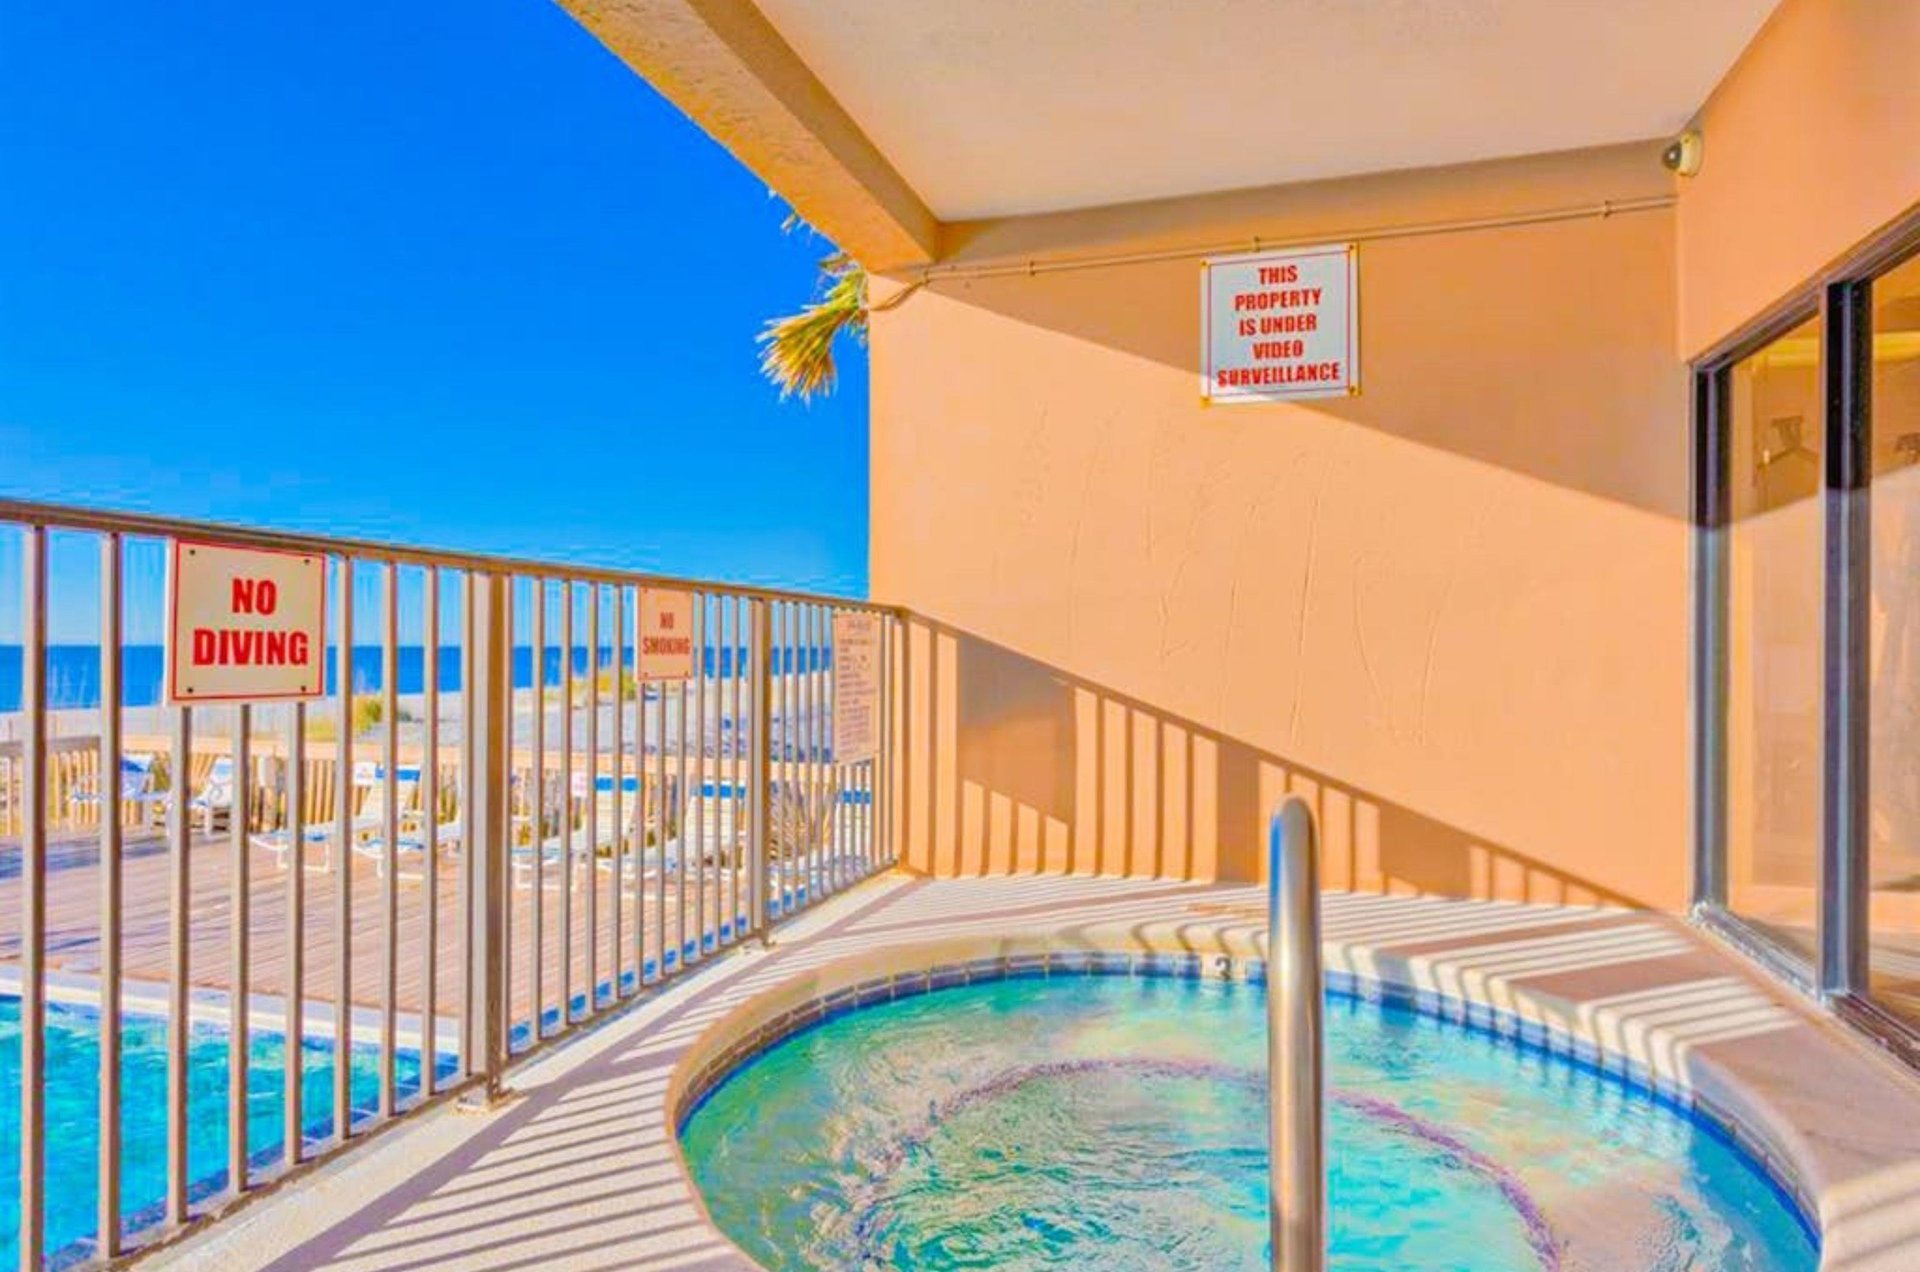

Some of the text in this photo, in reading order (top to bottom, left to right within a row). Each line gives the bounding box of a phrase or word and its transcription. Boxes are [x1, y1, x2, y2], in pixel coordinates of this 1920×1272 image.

[1258, 265, 1298, 285] THIS
[1235, 288, 1322, 311] PROPERTY
[1239, 313, 1318, 336] IS UNDER
[1253, 339, 1303, 360] VIDEO
[1217, 362, 1340, 387] SURVEILLANCE
[232, 578, 277, 615] NO
[660, 612, 674, 629] NO
[193, 628, 308, 666] DIVING
[643, 637, 690, 655] SMOKING
